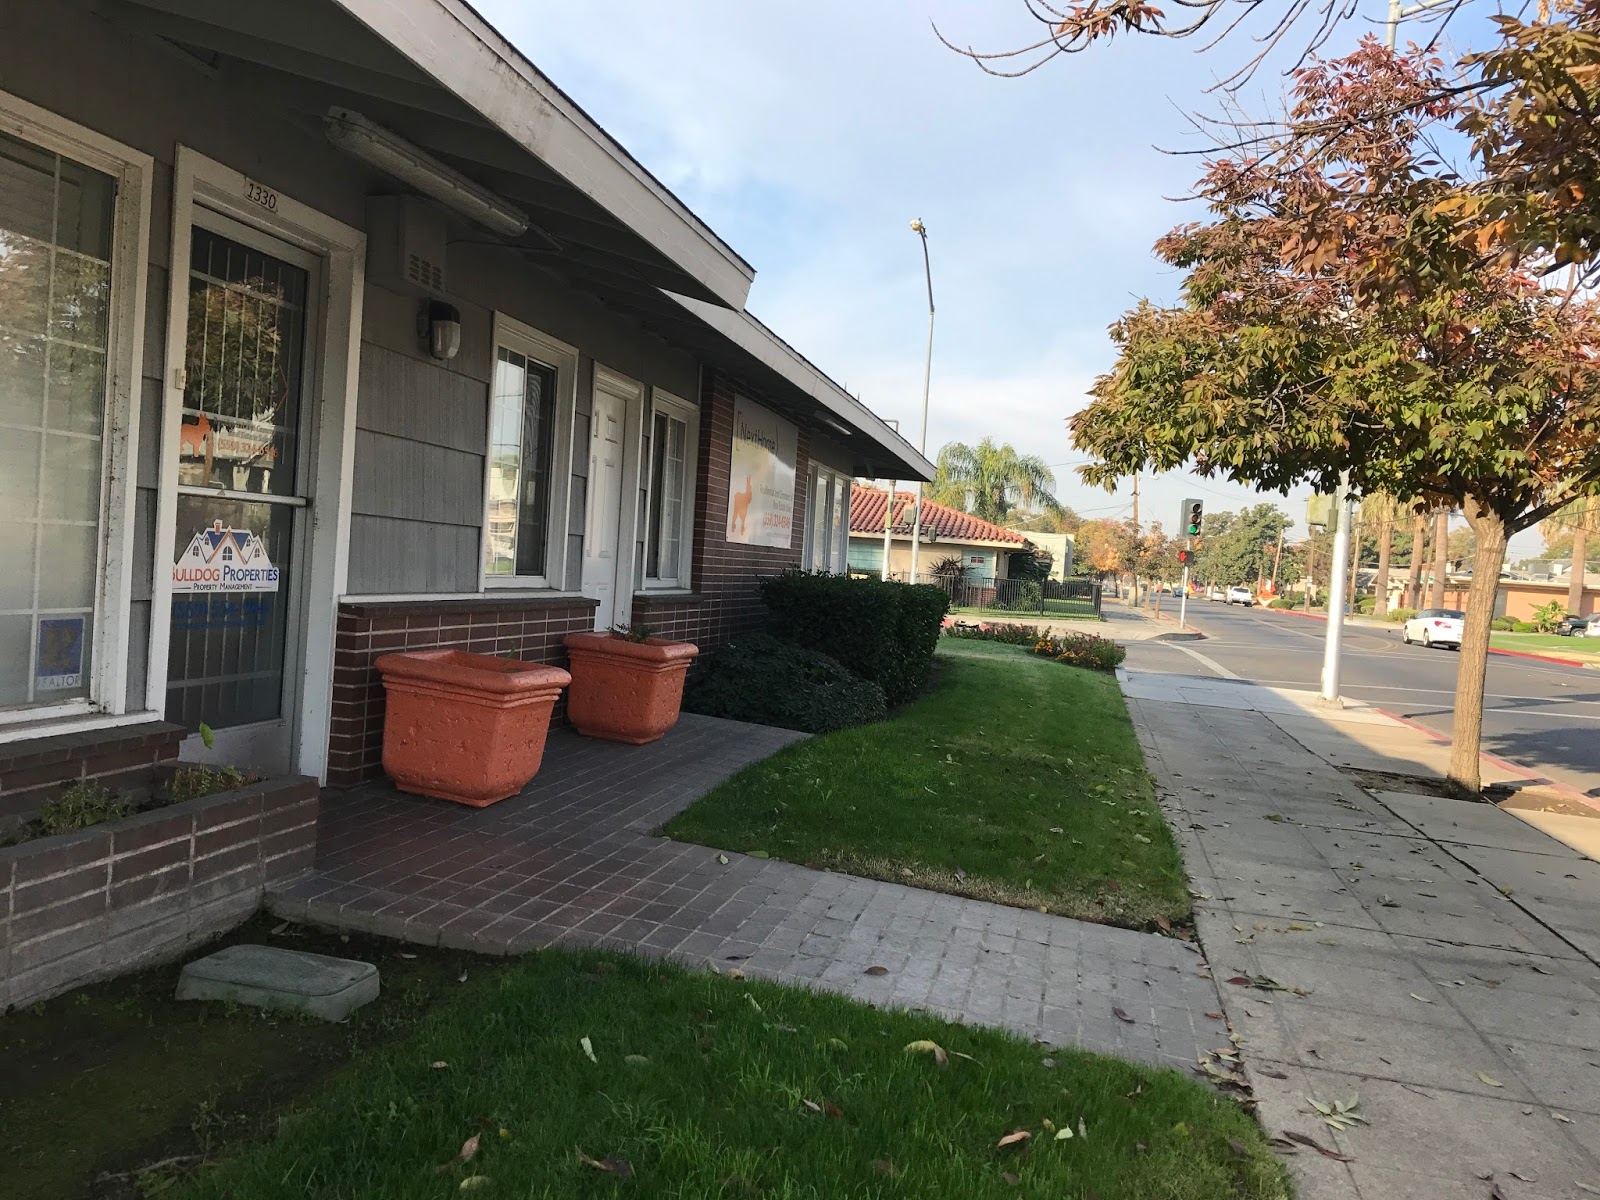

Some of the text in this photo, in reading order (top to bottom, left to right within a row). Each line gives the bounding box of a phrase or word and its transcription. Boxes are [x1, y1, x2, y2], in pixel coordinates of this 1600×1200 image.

[247, 184, 277, 208] 1330
[223, 565, 278, 582] PROPERTIES
[193, 582, 253, 591] PROPERTY MANAGEMENT
